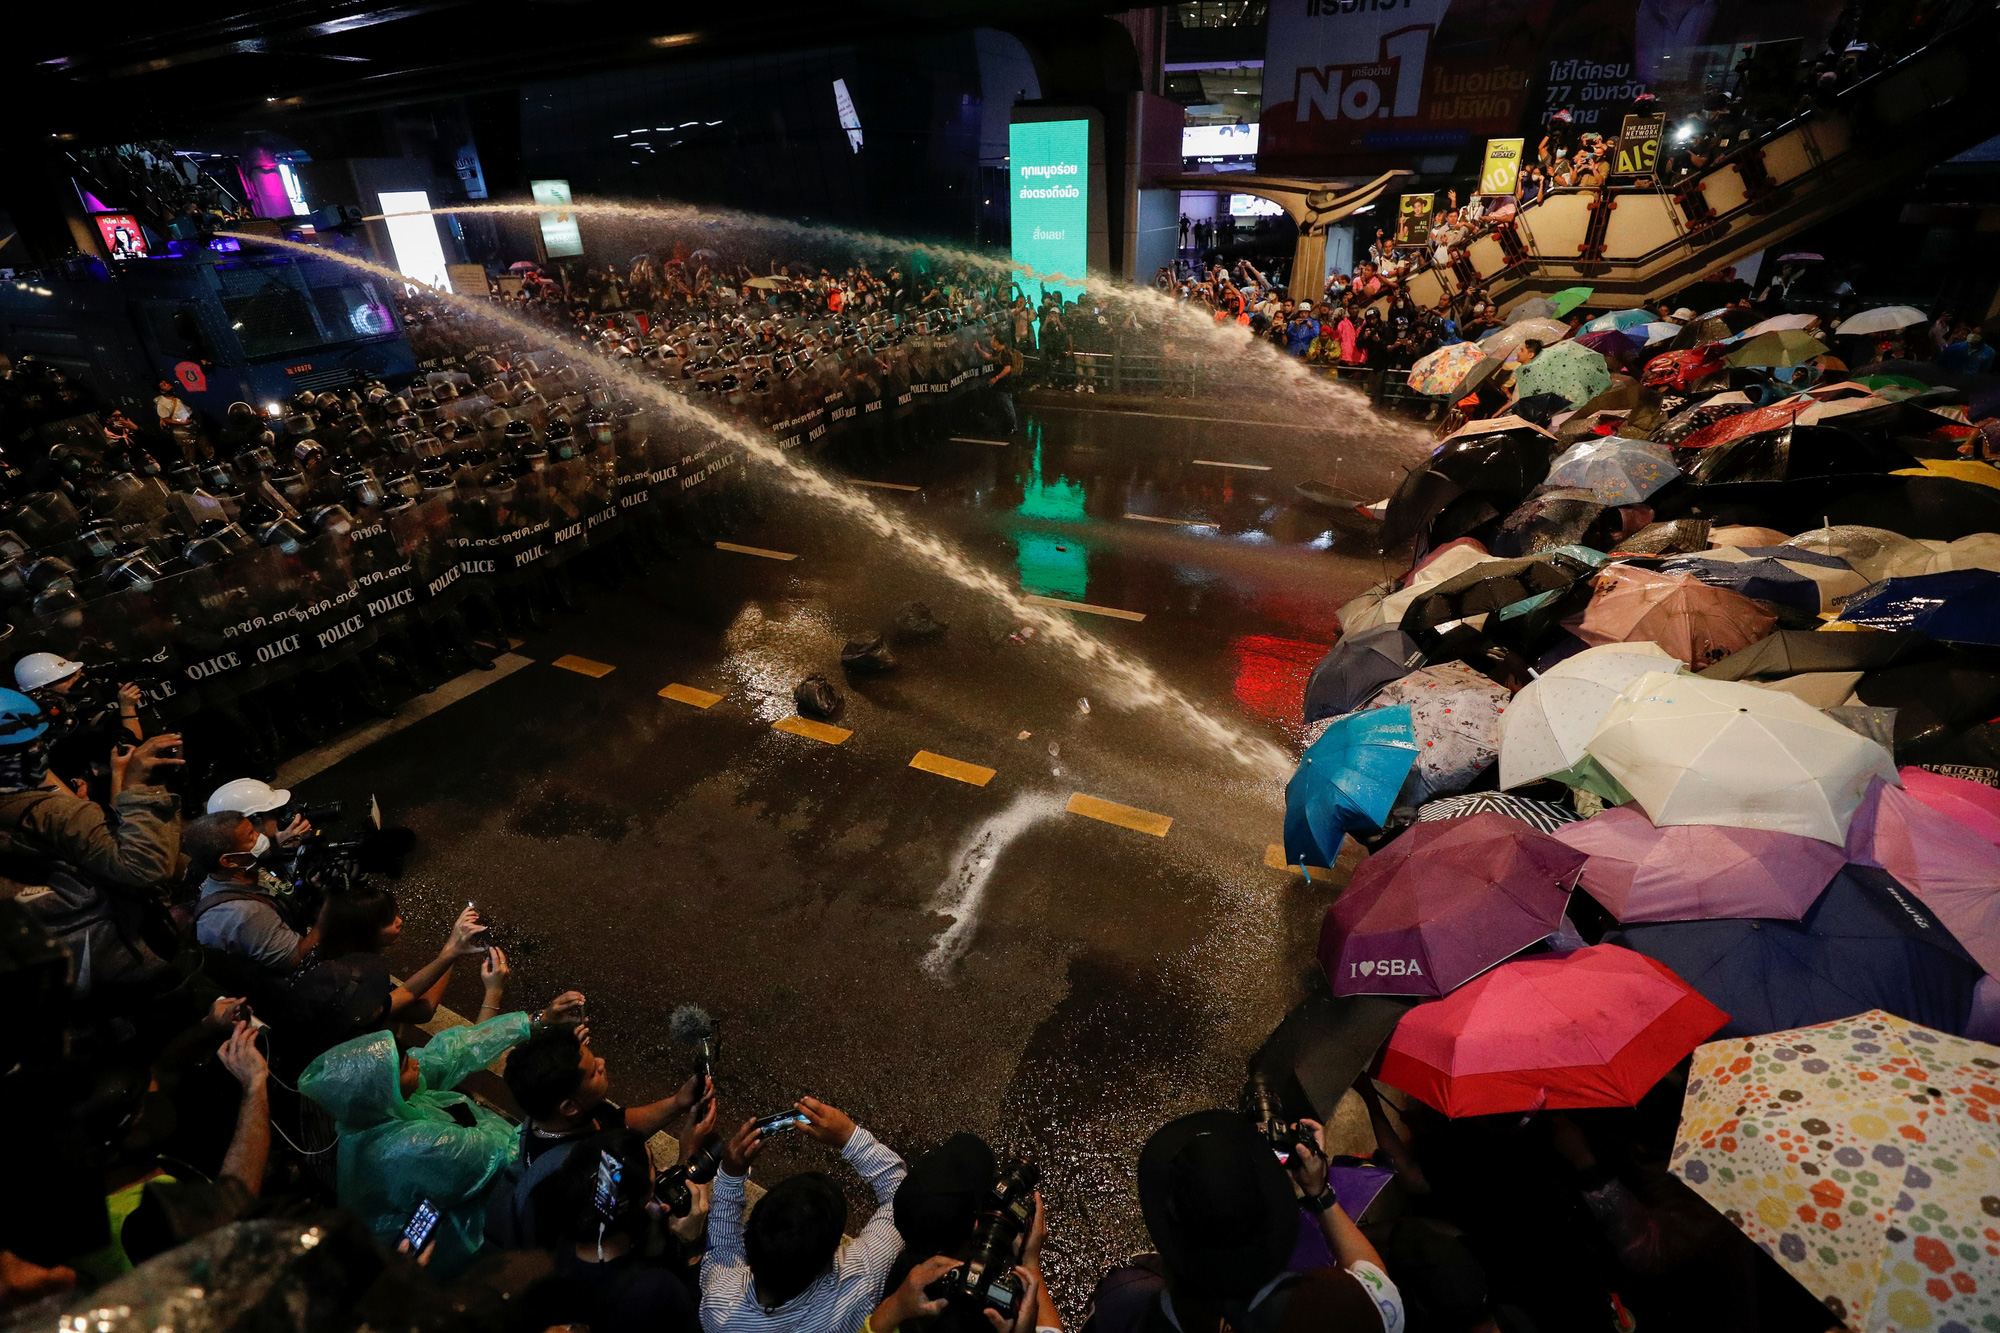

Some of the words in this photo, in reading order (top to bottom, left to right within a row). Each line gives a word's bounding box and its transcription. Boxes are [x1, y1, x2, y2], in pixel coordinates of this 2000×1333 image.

[1549, 59, 1630, 82] ใช้ได้ครบ
[1546, 86, 1572, 103] 77
[1581, 80, 1646, 101] จังหวัด
[1541, 103, 1600, 126] ทั่ไทย
[1618, 140, 1658, 172] AIS
[1021, 162, 1078, 179] ทุกเมนูอร่อย
[1019, 185, 1079, 199] ส่งตรงถึงมือ
[1033, 226, 1065, 240] สั่งเลย!
[865, 400, 882, 413] POLICE
[780, 434, 801, 450] POLICE
[707, 452, 736, 475] POLICE
[620, 490, 649, 508] OLICE
[554, 522, 582, 545] POLICE
[460, 559, 496, 574] OLICE
[515, 544, 551, 568] POLIC
[428, 564, 461, 597] POLICE
[366, 587, 415, 618] POLICE
[316, 613, 365, 650] POLICE
[251, 633, 301, 668] OLICE
[184, 651, 242, 681] OLICE
